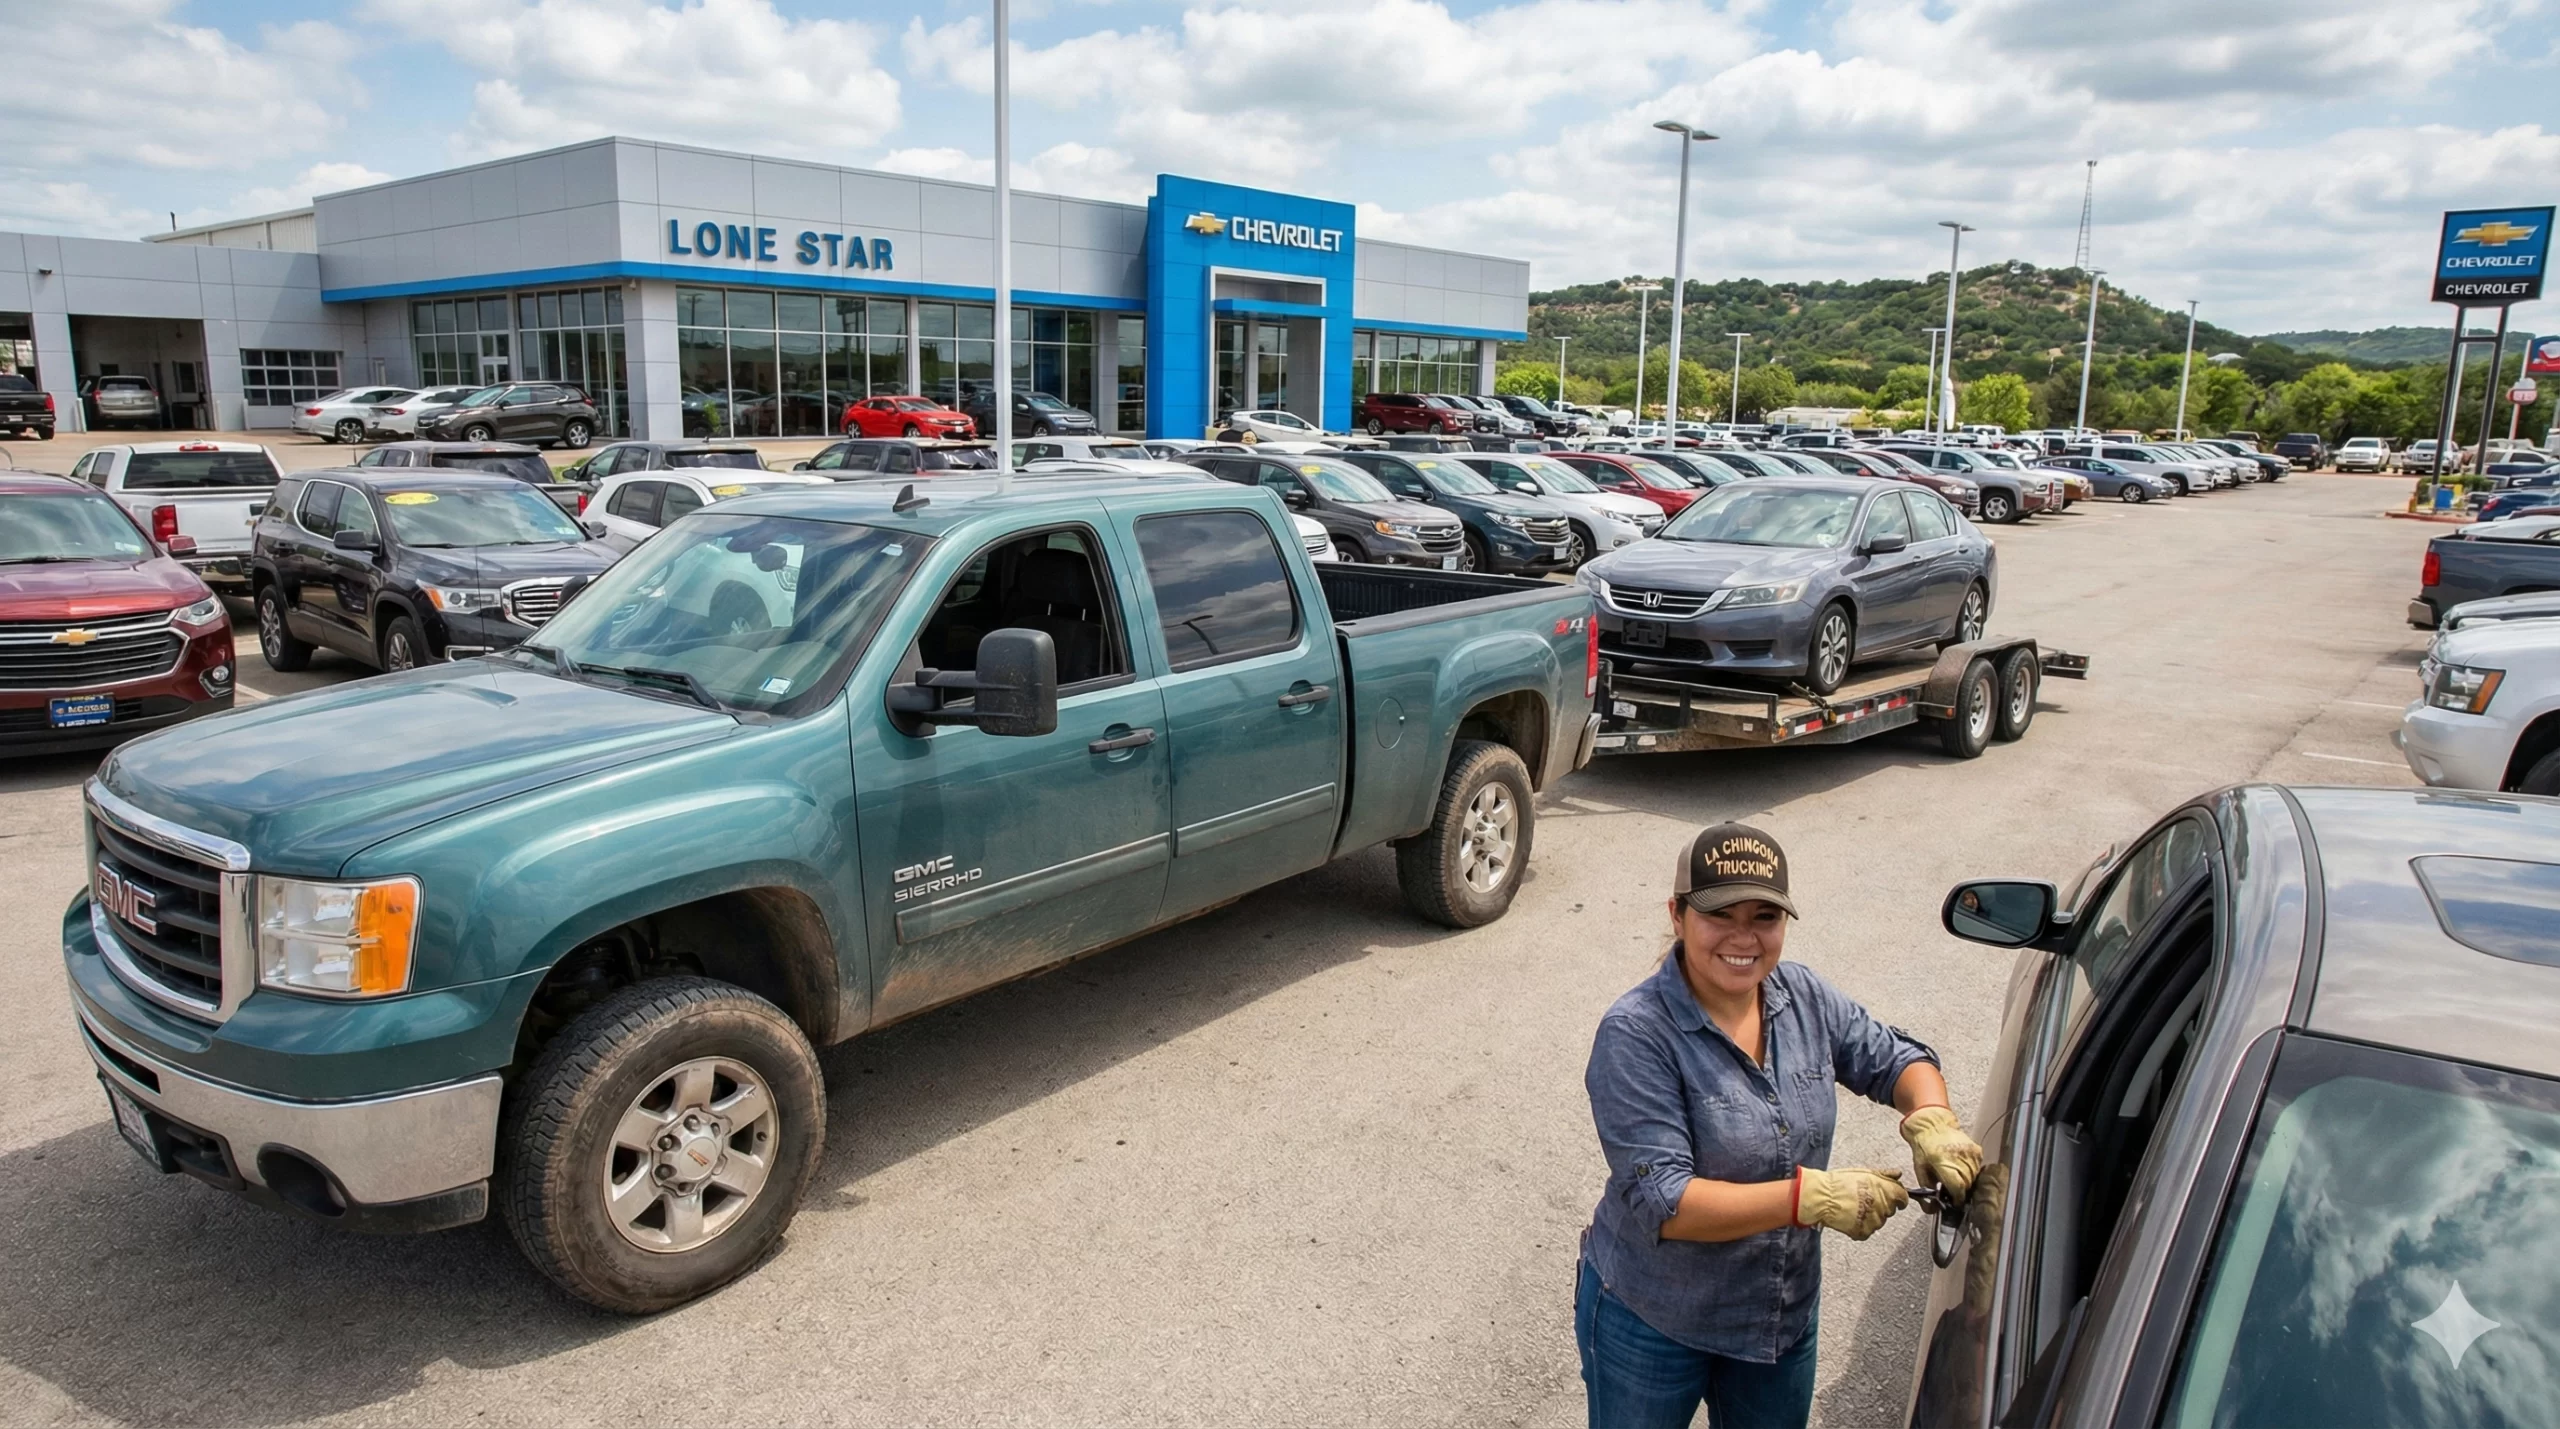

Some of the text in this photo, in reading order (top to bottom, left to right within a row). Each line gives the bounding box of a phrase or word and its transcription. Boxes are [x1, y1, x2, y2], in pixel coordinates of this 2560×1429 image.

[667, 219, 894, 270] LONE STAR
[1231, 216, 1343, 252] CHEVROLET
[2446, 255, 2537, 268] CHEVROLET
[2445, 283, 2530, 295] CHEVROLET
[894, 855, 954, 883] GMC
[1704, 847, 1720, 866] LA
[95, 862, 157, 935] GMC
